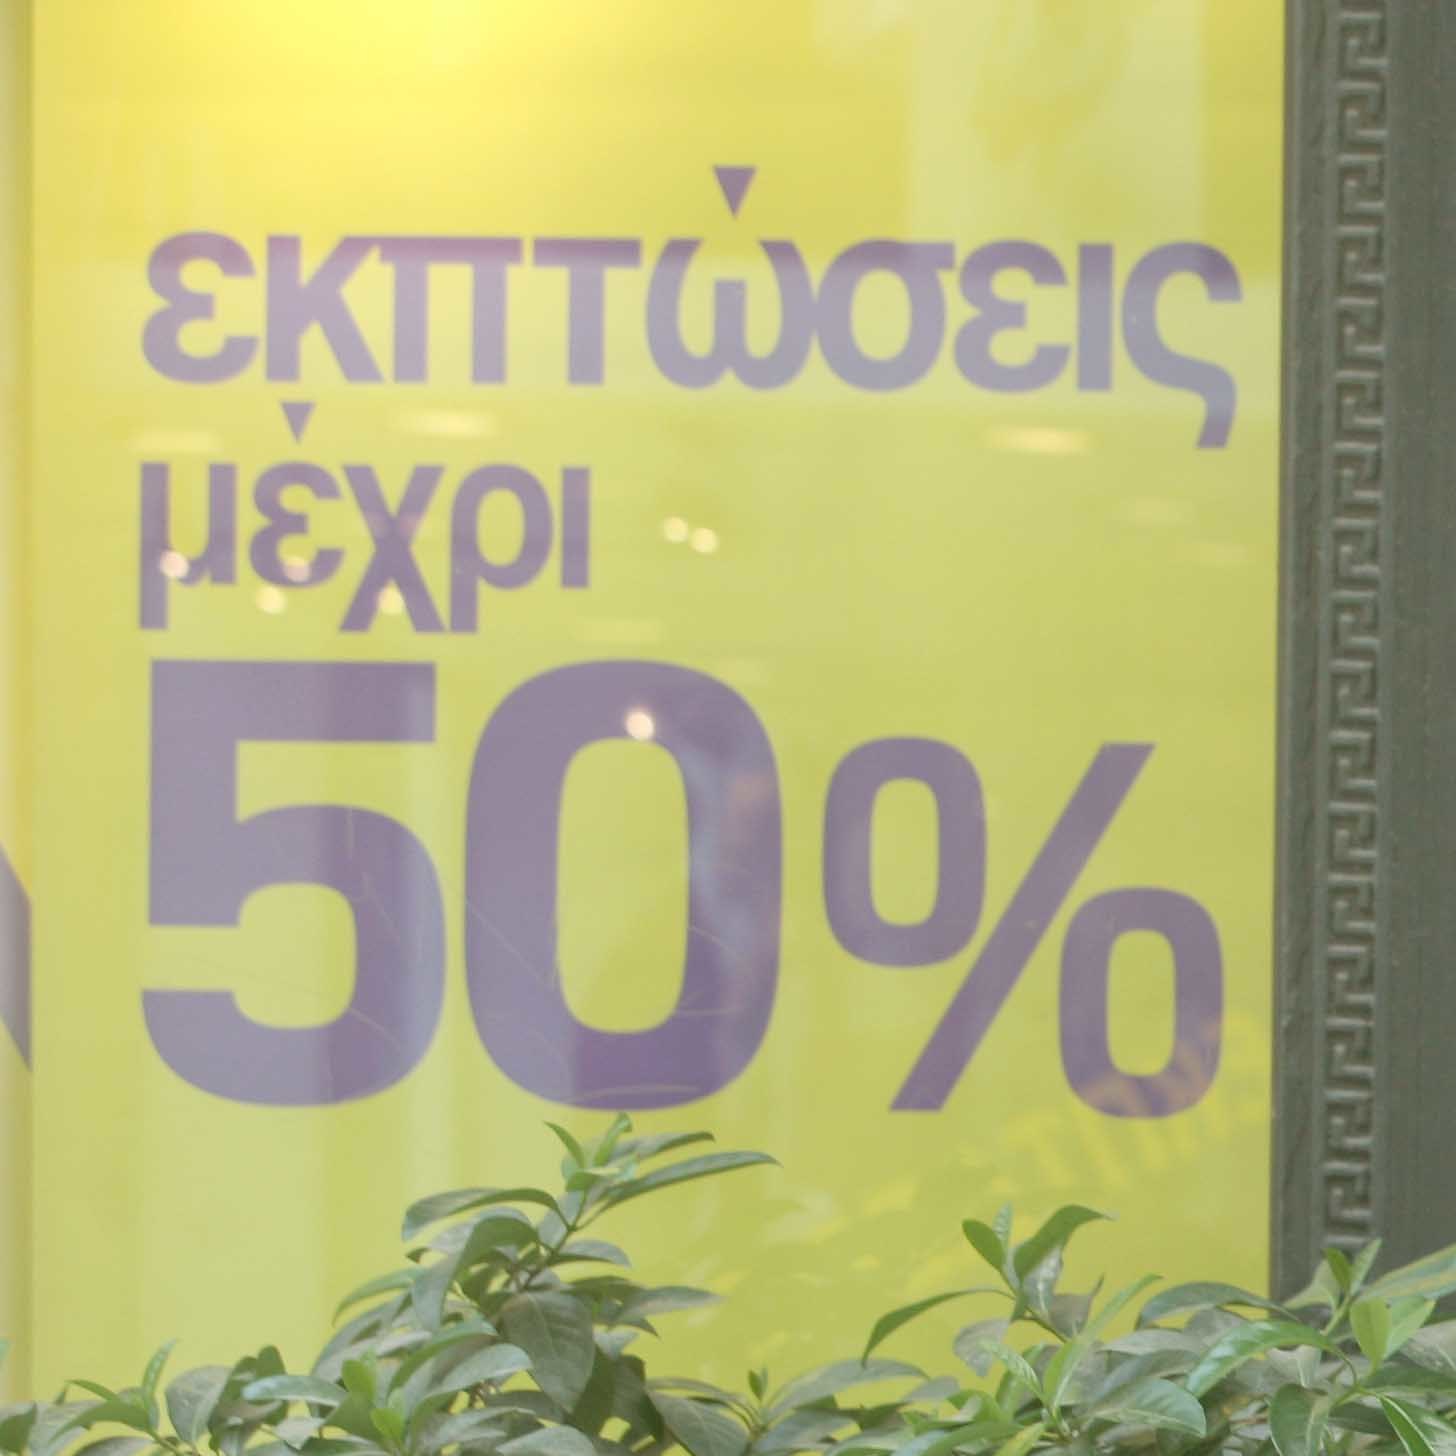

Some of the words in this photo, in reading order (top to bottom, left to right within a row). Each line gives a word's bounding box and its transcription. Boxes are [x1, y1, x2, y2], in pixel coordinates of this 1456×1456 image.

[142, 165, 1243, 449] εκπτώσεις
[139, 402, 591, 634] μέχρι
[141, 659, 1225, 1119] 50%
